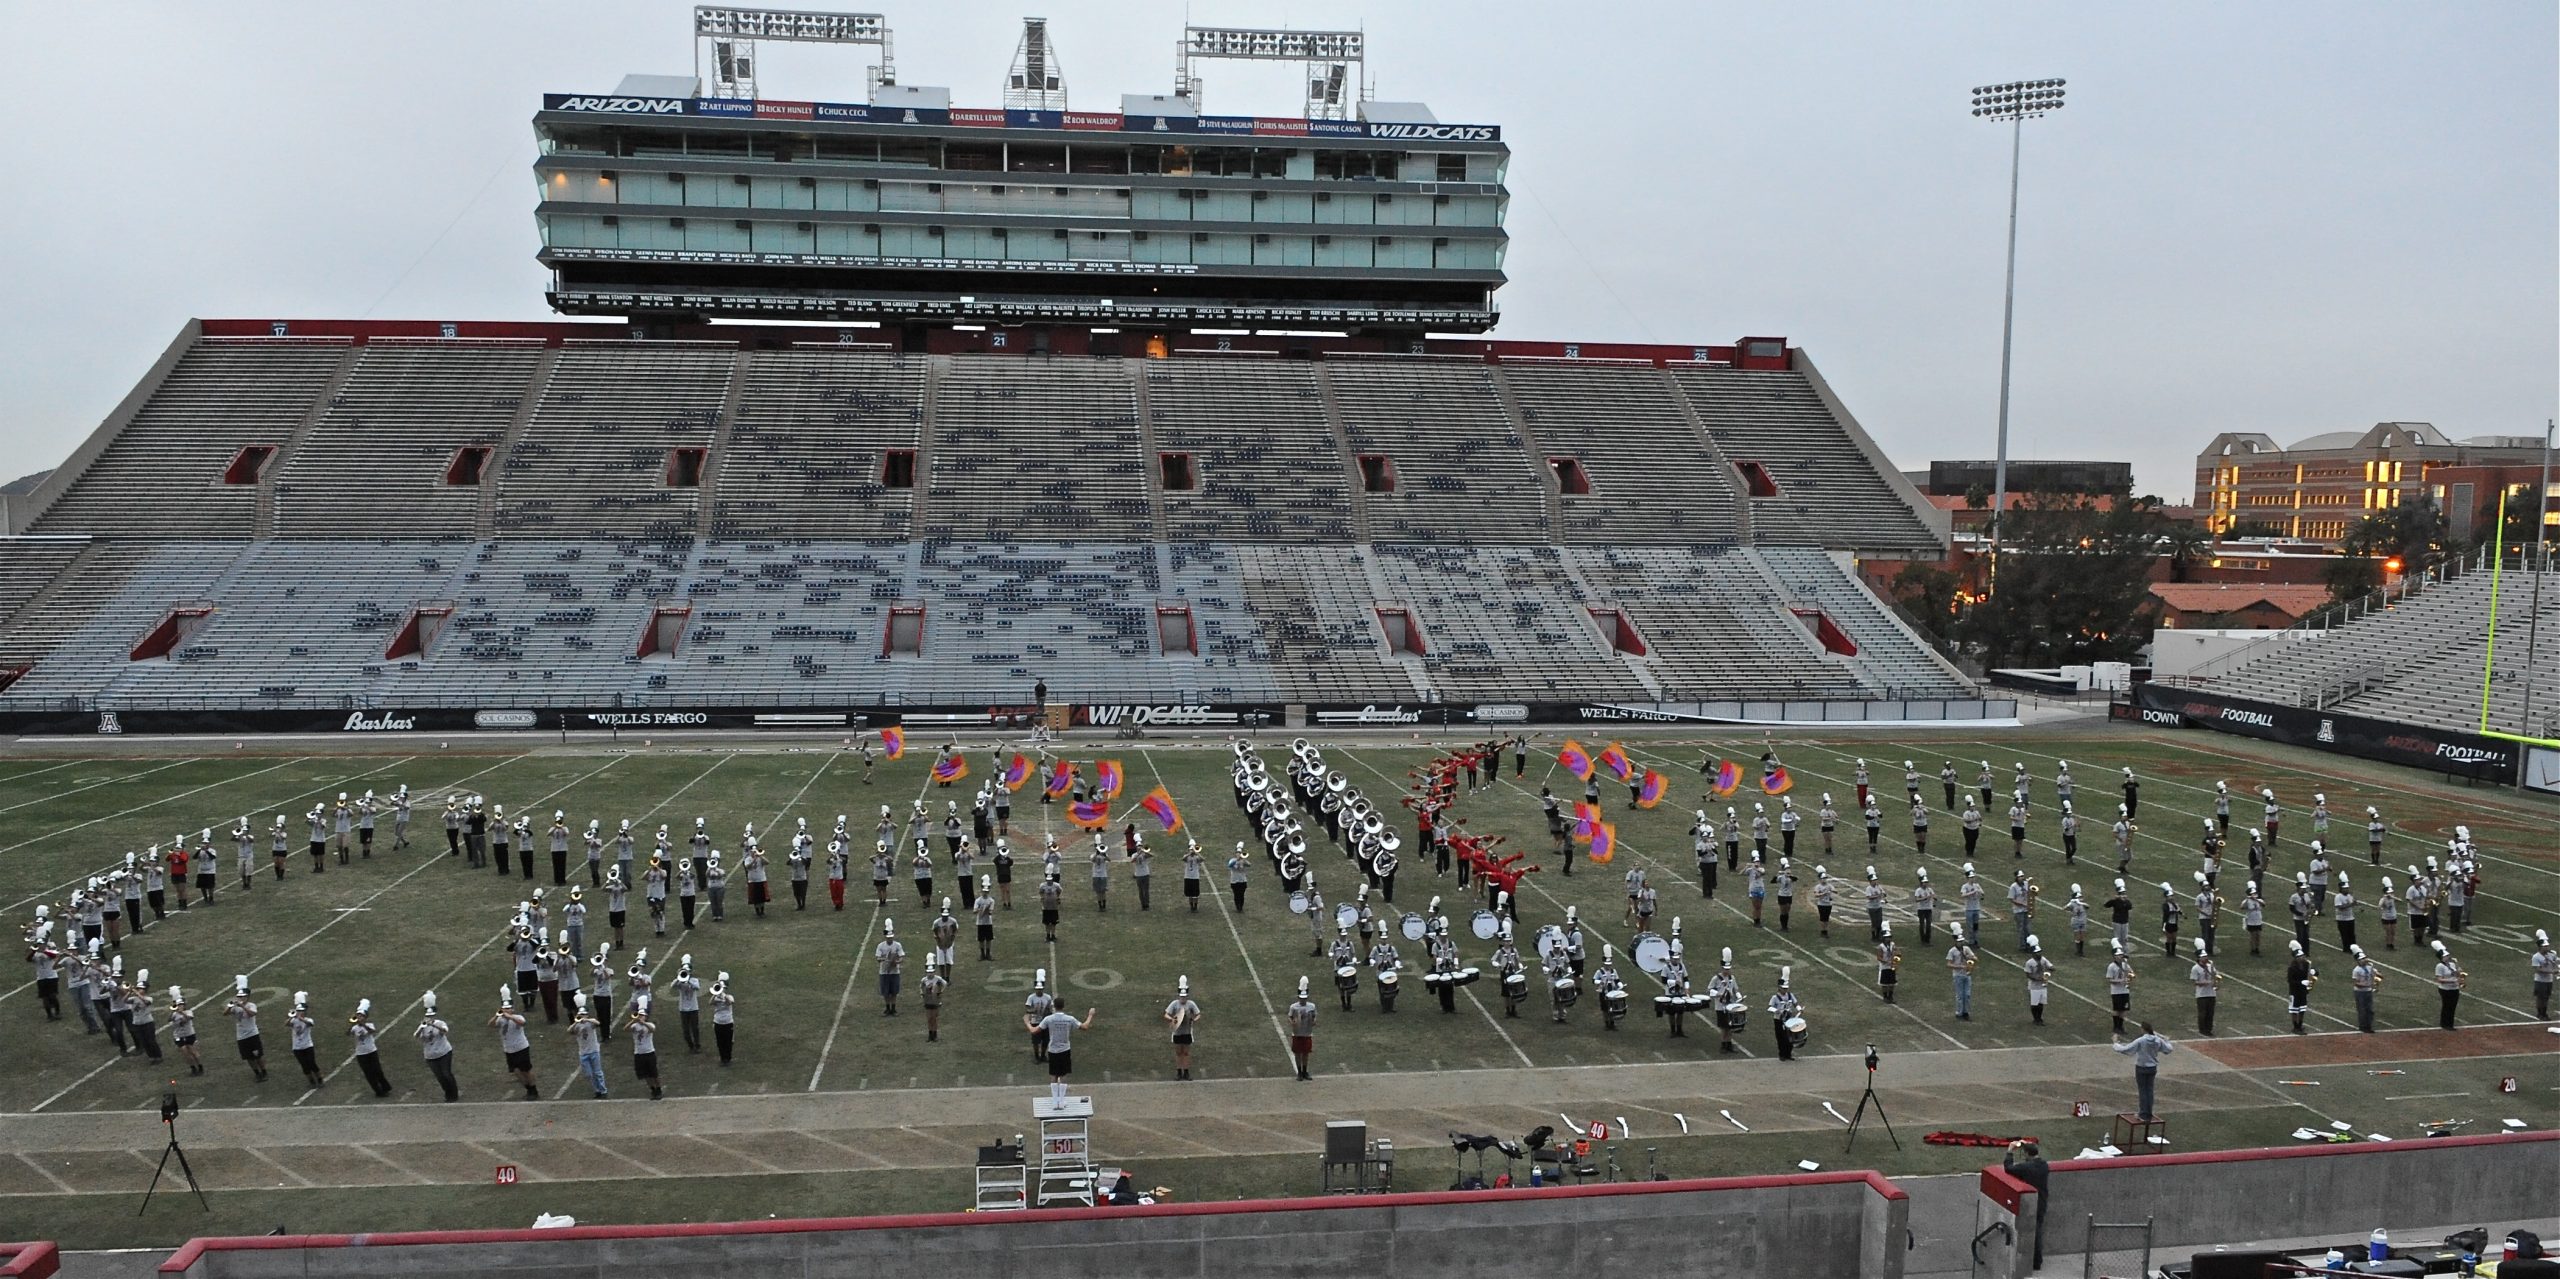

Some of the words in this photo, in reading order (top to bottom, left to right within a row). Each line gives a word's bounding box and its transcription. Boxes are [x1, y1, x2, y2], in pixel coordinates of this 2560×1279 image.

[558, 97, 683, 113] ARIZONA
[699, 101, 709, 110] 22
[709, 102, 722, 111] ART
[723, 103, 753, 112] LUPPINO
[766, 105, 786, 114] RICKY
[787, 106, 813, 115] HUNLEY
[825, 108, 848, 116] CHUCK
[849, 109, 868, 117] CECIL
[955, 113, 984, 122] DARRYLL
[984, 114, 1005, 122] LEWIS
[1087, 117, 1118, 125] WALDROP
[1206, 120, 1221, 128] STEVE
[1278, 122, 1307, 130] McALISTER
[1314, 123, 1339, 132] ANTOINE
[1340, 125, 1361, 133] CASON
[1370, 124, 1494, 140] WILDCATS
[273, 327, 285, 337] 17
[443, 328, 455, 338] 18
[631, 331, 643, 340] 19
[839, 334, 853, 343] 20
[993, 337, 1005, 346] 21
[1218, 342, 1231, 351] 22
[1412, 345, 1424, 354] 23
[1566, 349, 1578, 358] 24
[1695, 353, 1707, 362] 25
[497, 714, 531, 722] CASINOS
[1580, 707, 1629, 719] WELLS
[2143, 709, 2179, 725] DOWN
[2220, 707, 2273, 727] FOOTBALL
[343, 711, 416, 731] Bashas'
[595, 714, 652, 725] WELLS
[654, 713, 707, 724] FARGO
[983, 967, 1126, 993] 50
[2504, 1078, 2516, 1092] 20
[2076, 1102, 2090, 1117] 30
[1590, 1122, 1604, 1138] 40
[1055, 1138, 1071, 1153] 50
[498, 1167, 515, 1183] 40
